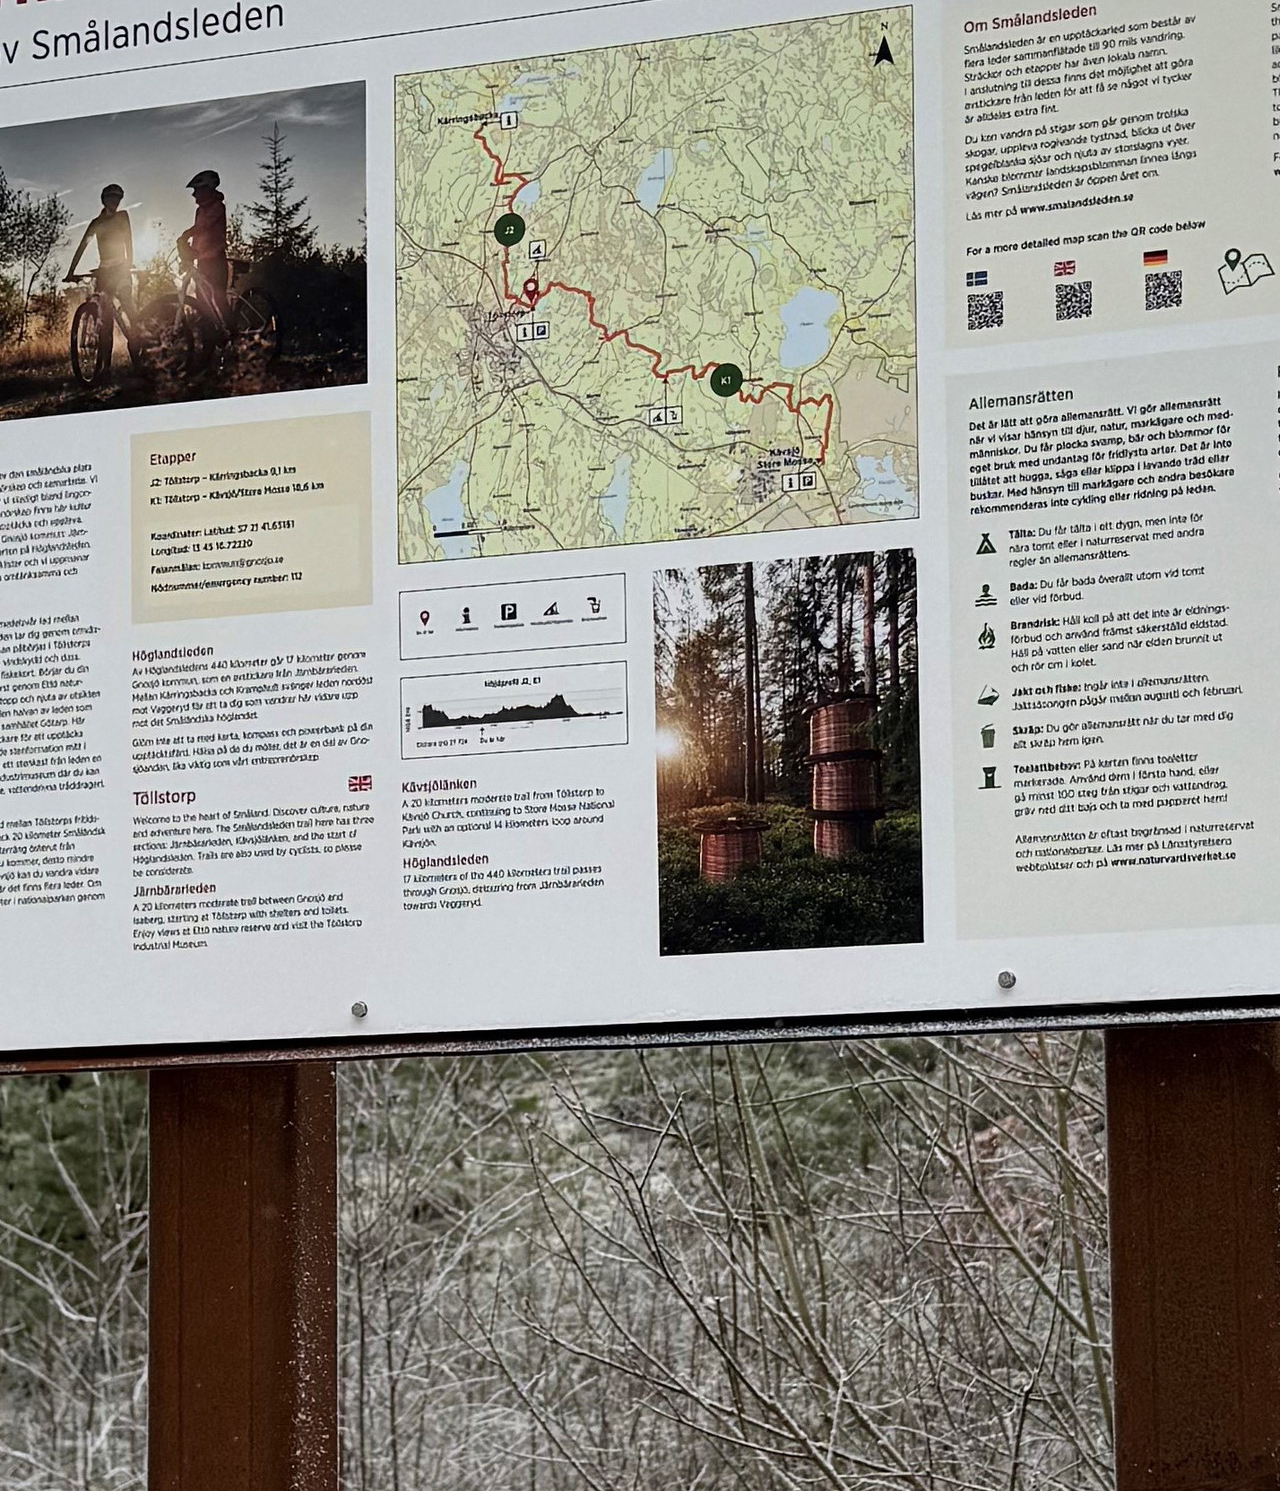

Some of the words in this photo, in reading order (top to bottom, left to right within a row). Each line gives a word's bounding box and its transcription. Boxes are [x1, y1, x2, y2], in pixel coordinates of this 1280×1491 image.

[964, 21, 987, 33] Om
[992, 5, 1096, 29] Smålandsleden
[32, 2, 283, 59] Smålandsleden
[1006, 206, 1017, 216] på
[966, 247, 981, 256] For
[993, 243, 1018, 252] more
[1021, 237, 1060, 249] detailed
[1063, 236, 1084, 244] map
[1087, 232, 1109, 241] scan
[1112, 230, 1128, 238] the
[1131, 226, 1145, 236] QR
[1149, 223, 1172, 234] code
[1176, 221, 1205, 231] below
[721, 376, 730, 384] K1
[969, 390, 1073, 409] Allemansrätten
[150, 452, 196, 465] Etapper
[133, 790, 195, 805] Töllstorp
